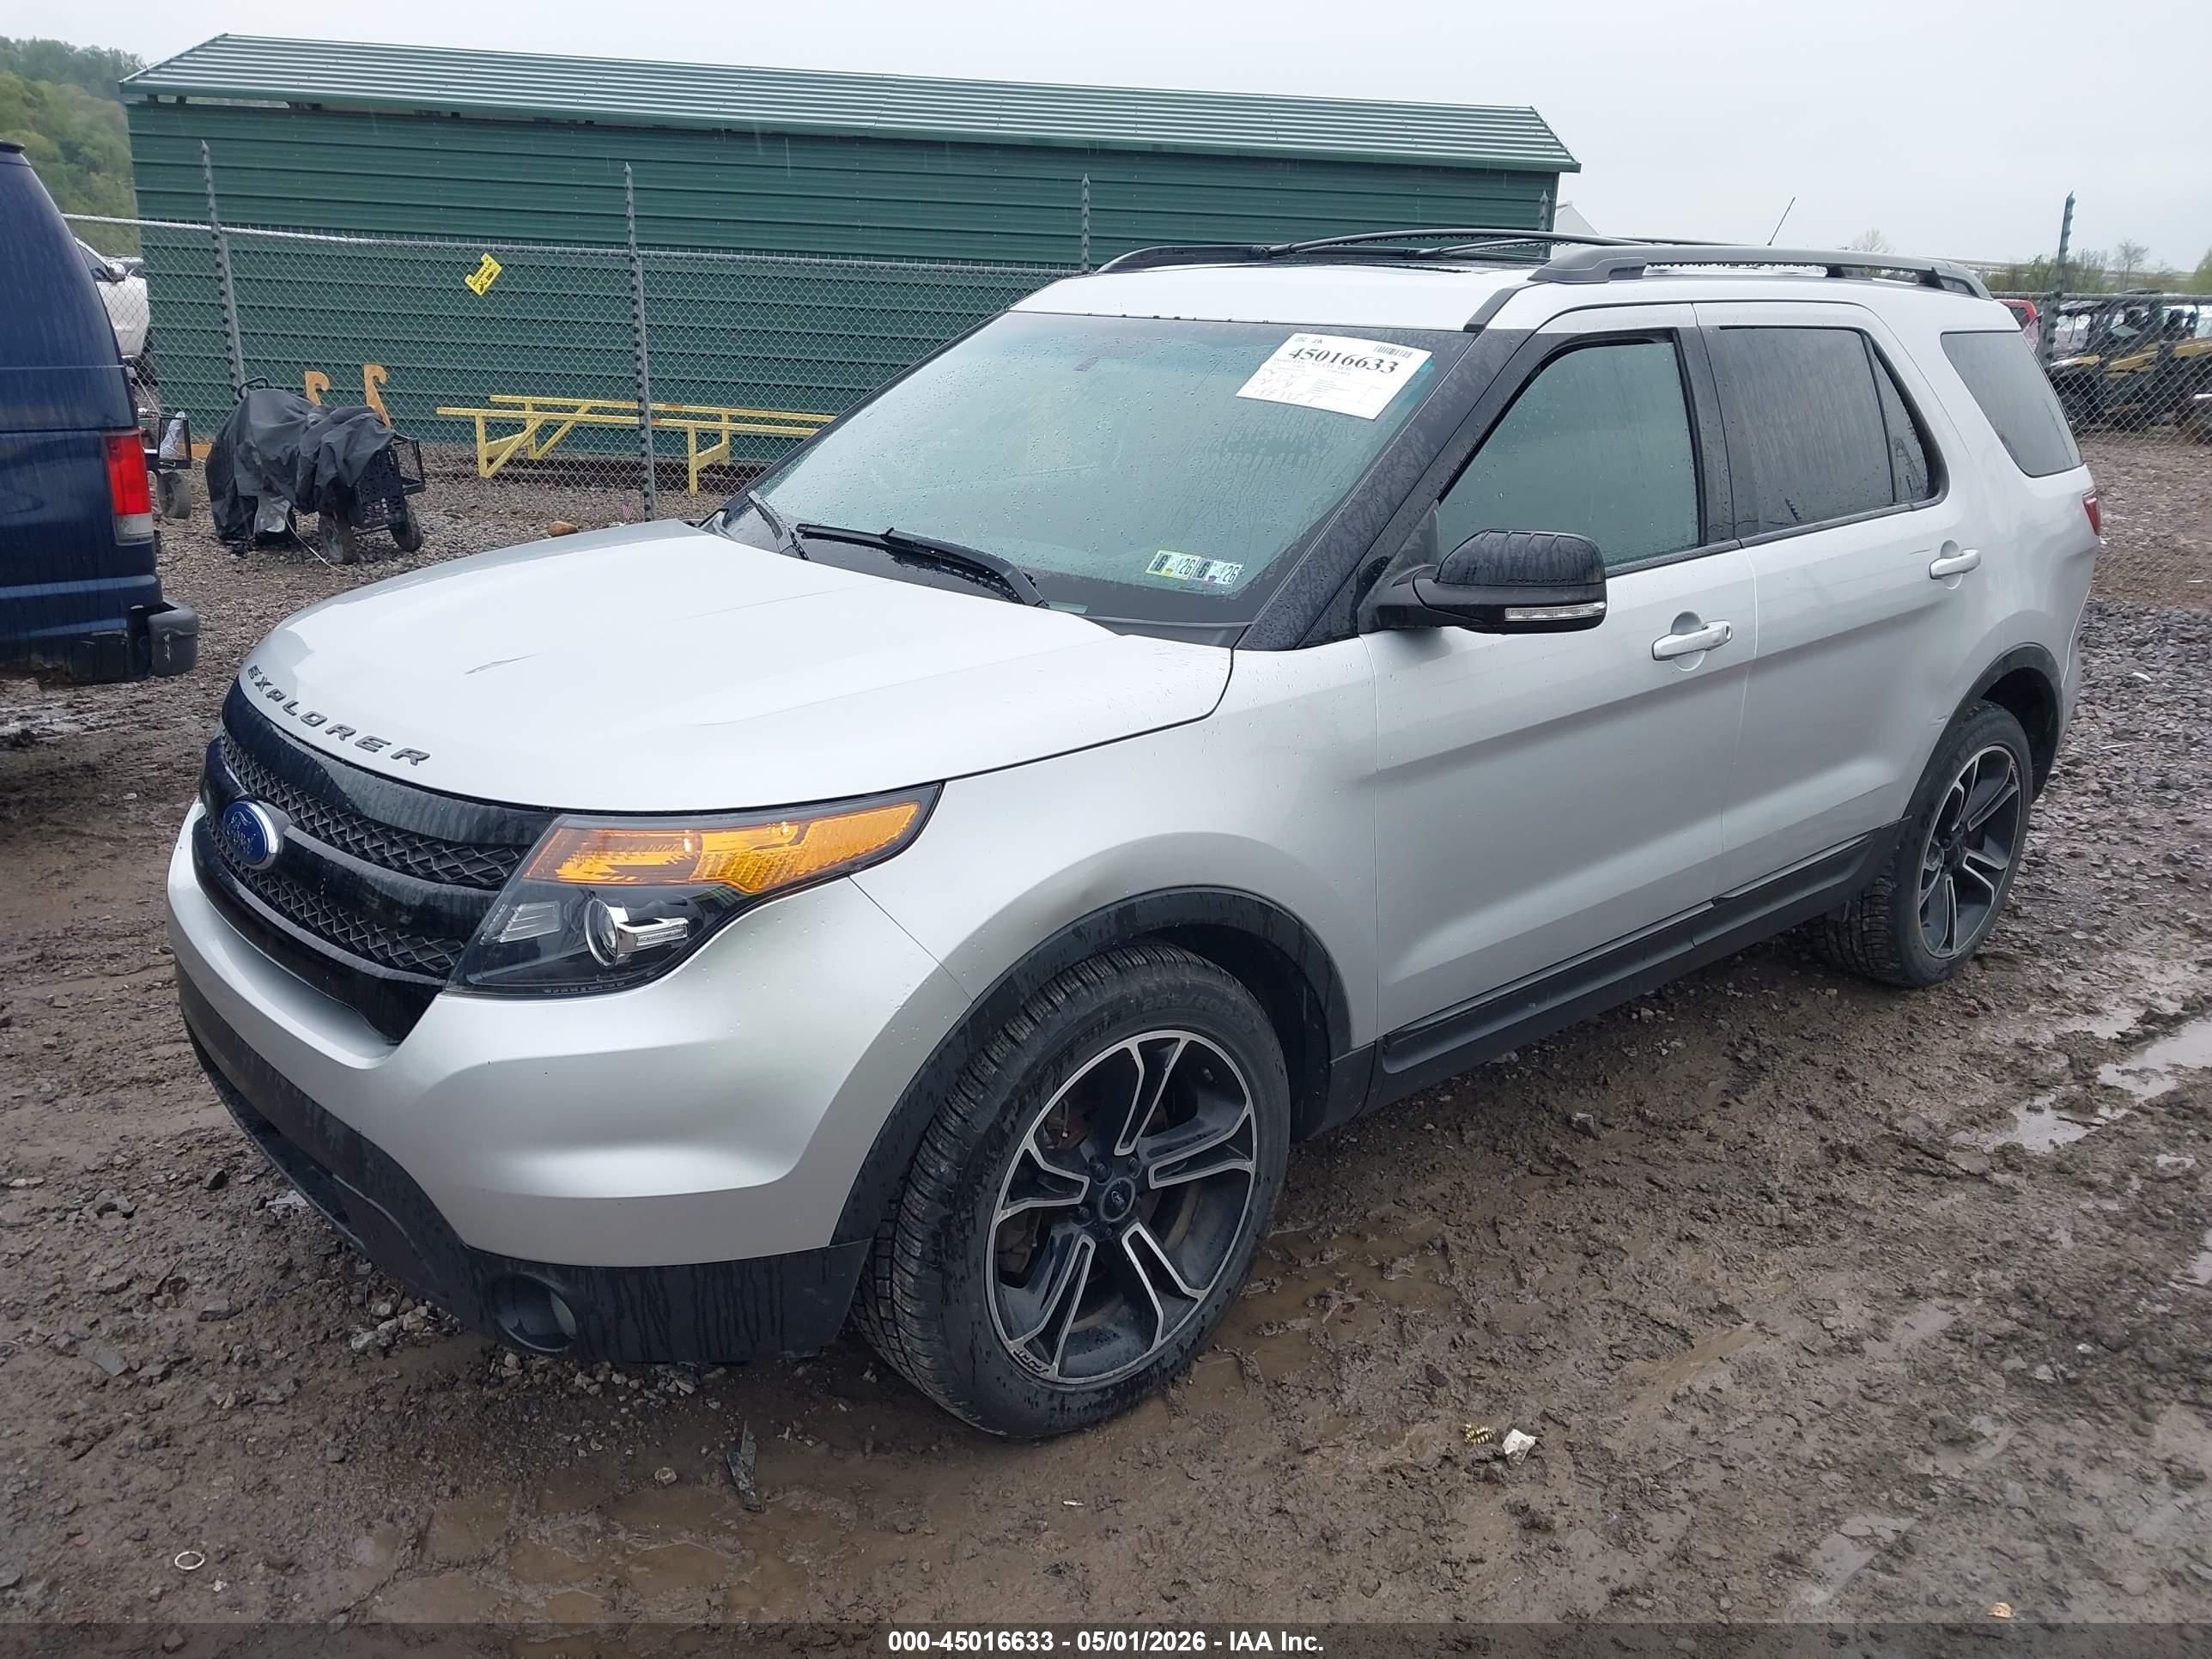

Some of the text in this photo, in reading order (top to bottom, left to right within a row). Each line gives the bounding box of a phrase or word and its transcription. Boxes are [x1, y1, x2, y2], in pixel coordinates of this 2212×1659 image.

[1288, 347, 1399, 374] 45016633
[1178, 558, 1196, 575] 26
[1222, 565, 1239, 583] 26
[247, 665, 431, 766] EXPLORER
[1013, 1349, 1049, 1373] SPORT
